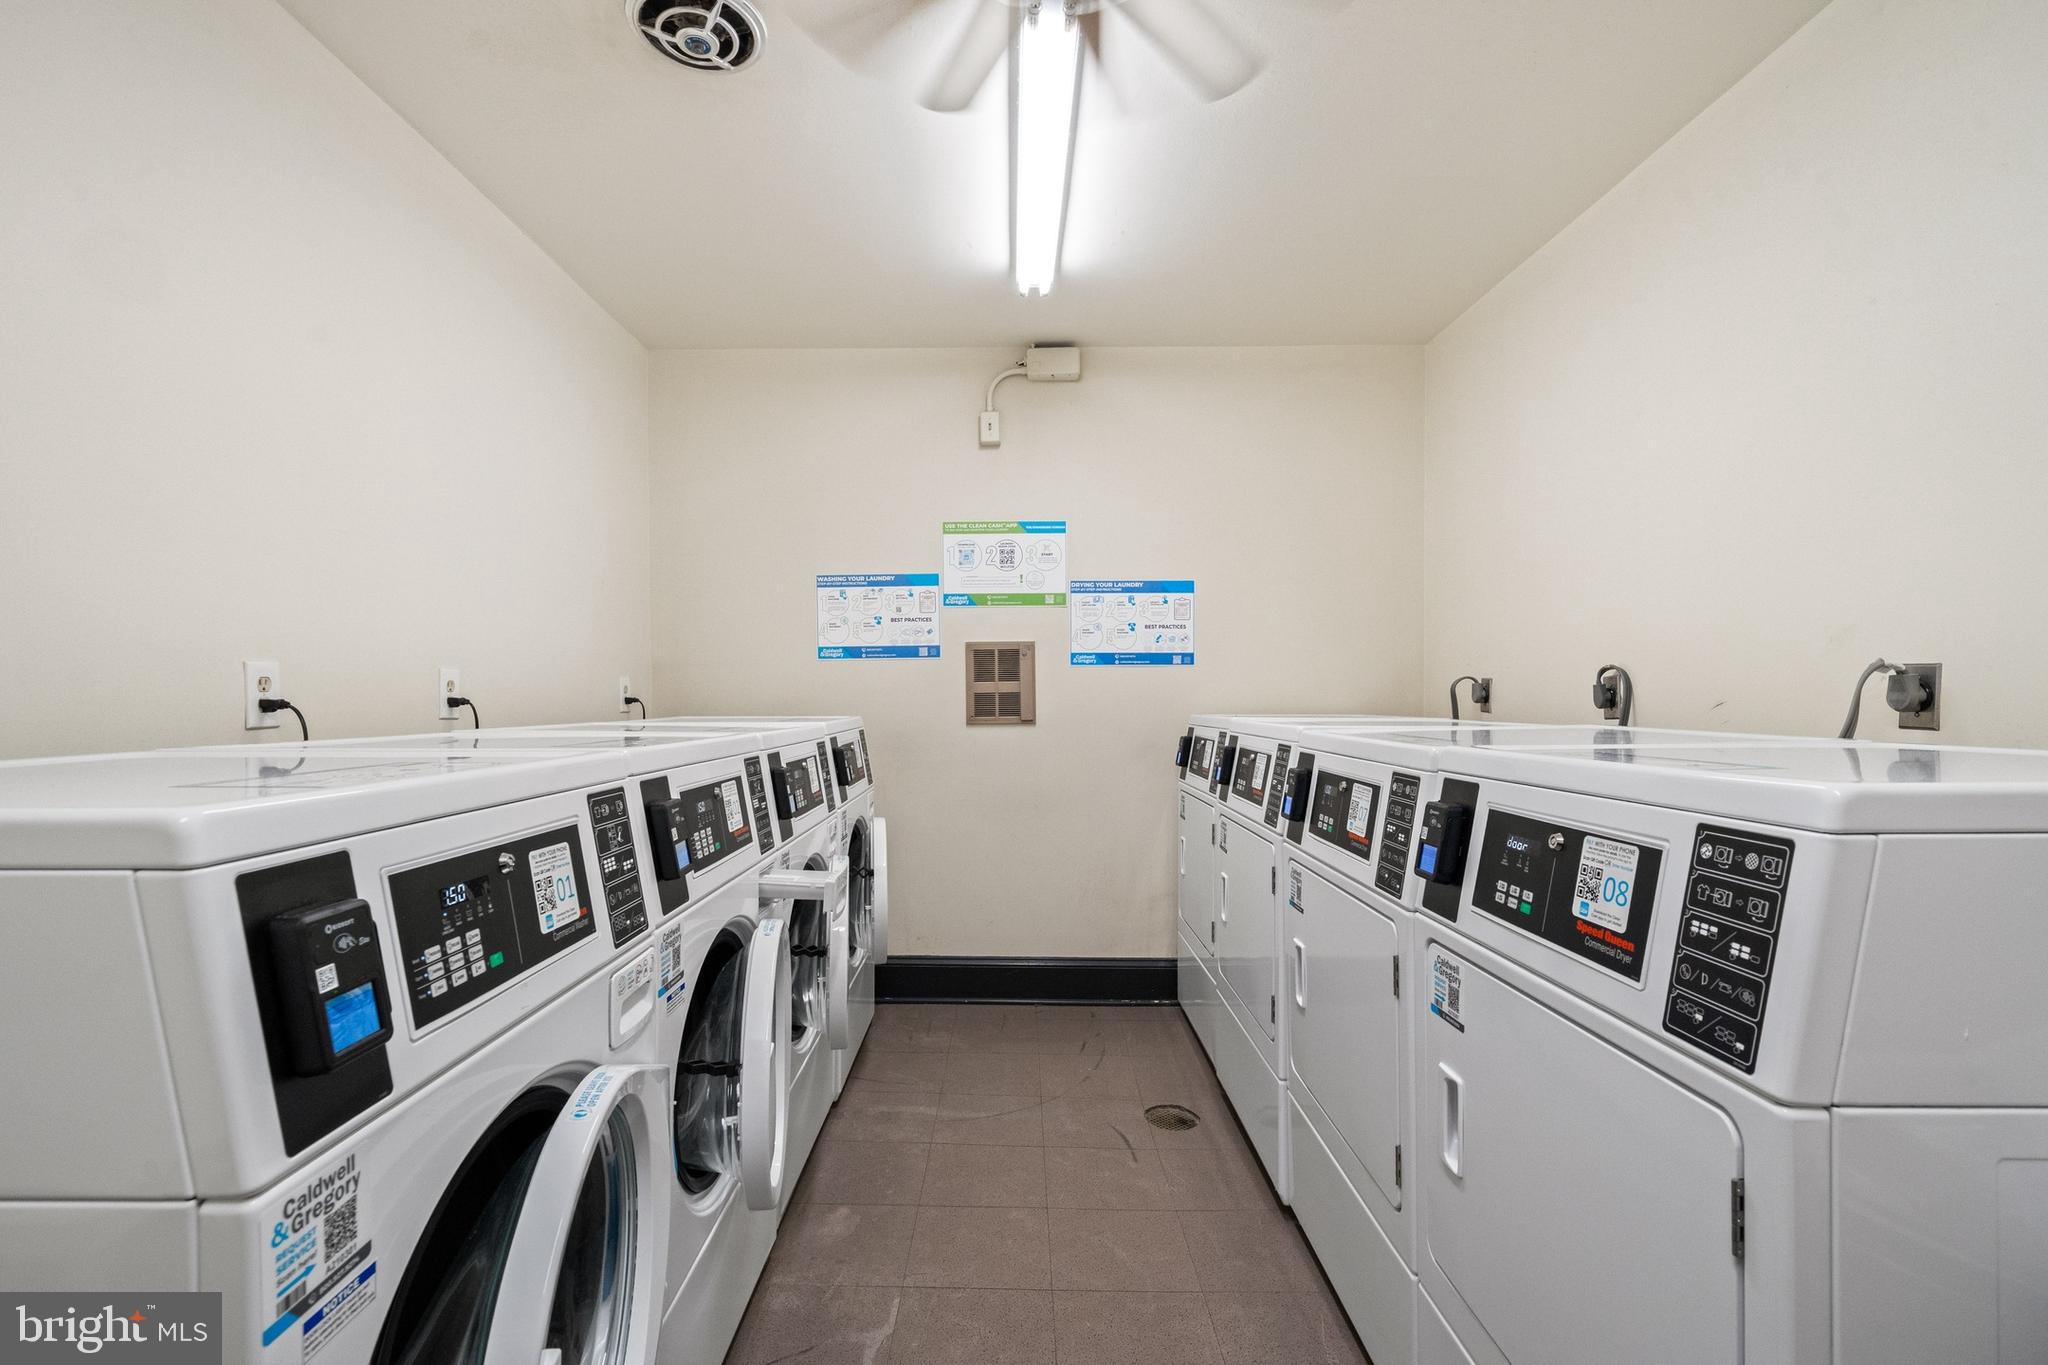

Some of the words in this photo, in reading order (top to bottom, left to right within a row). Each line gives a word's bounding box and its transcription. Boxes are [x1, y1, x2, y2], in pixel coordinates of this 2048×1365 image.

[1595, 841, 1606, 849] WITH
[1606, 843, 1619, 852] YOUR
[1619, 845, 1637, 856] PHONE
[556, 875, 575, 902] 01
[1603, 876, 1629, 907] 08
[1576, 919, 1604, 939] Speed
[1605, 930, 1636, 953] Queen
[1584, 936, 1616, 956] Commercial
[1616, 949, 1633, 964] Dryer
[1436, 954, 1460, 977] Caldwell
[1439, 966, 1461, 988] Gregory
[283, 1153, 356, 1220] Caldwell
[271, 1220, 289, 1249] &
[291, 1170, 361, 1234] Gregory
[322, 1276, 361, 1318] NOTICE
